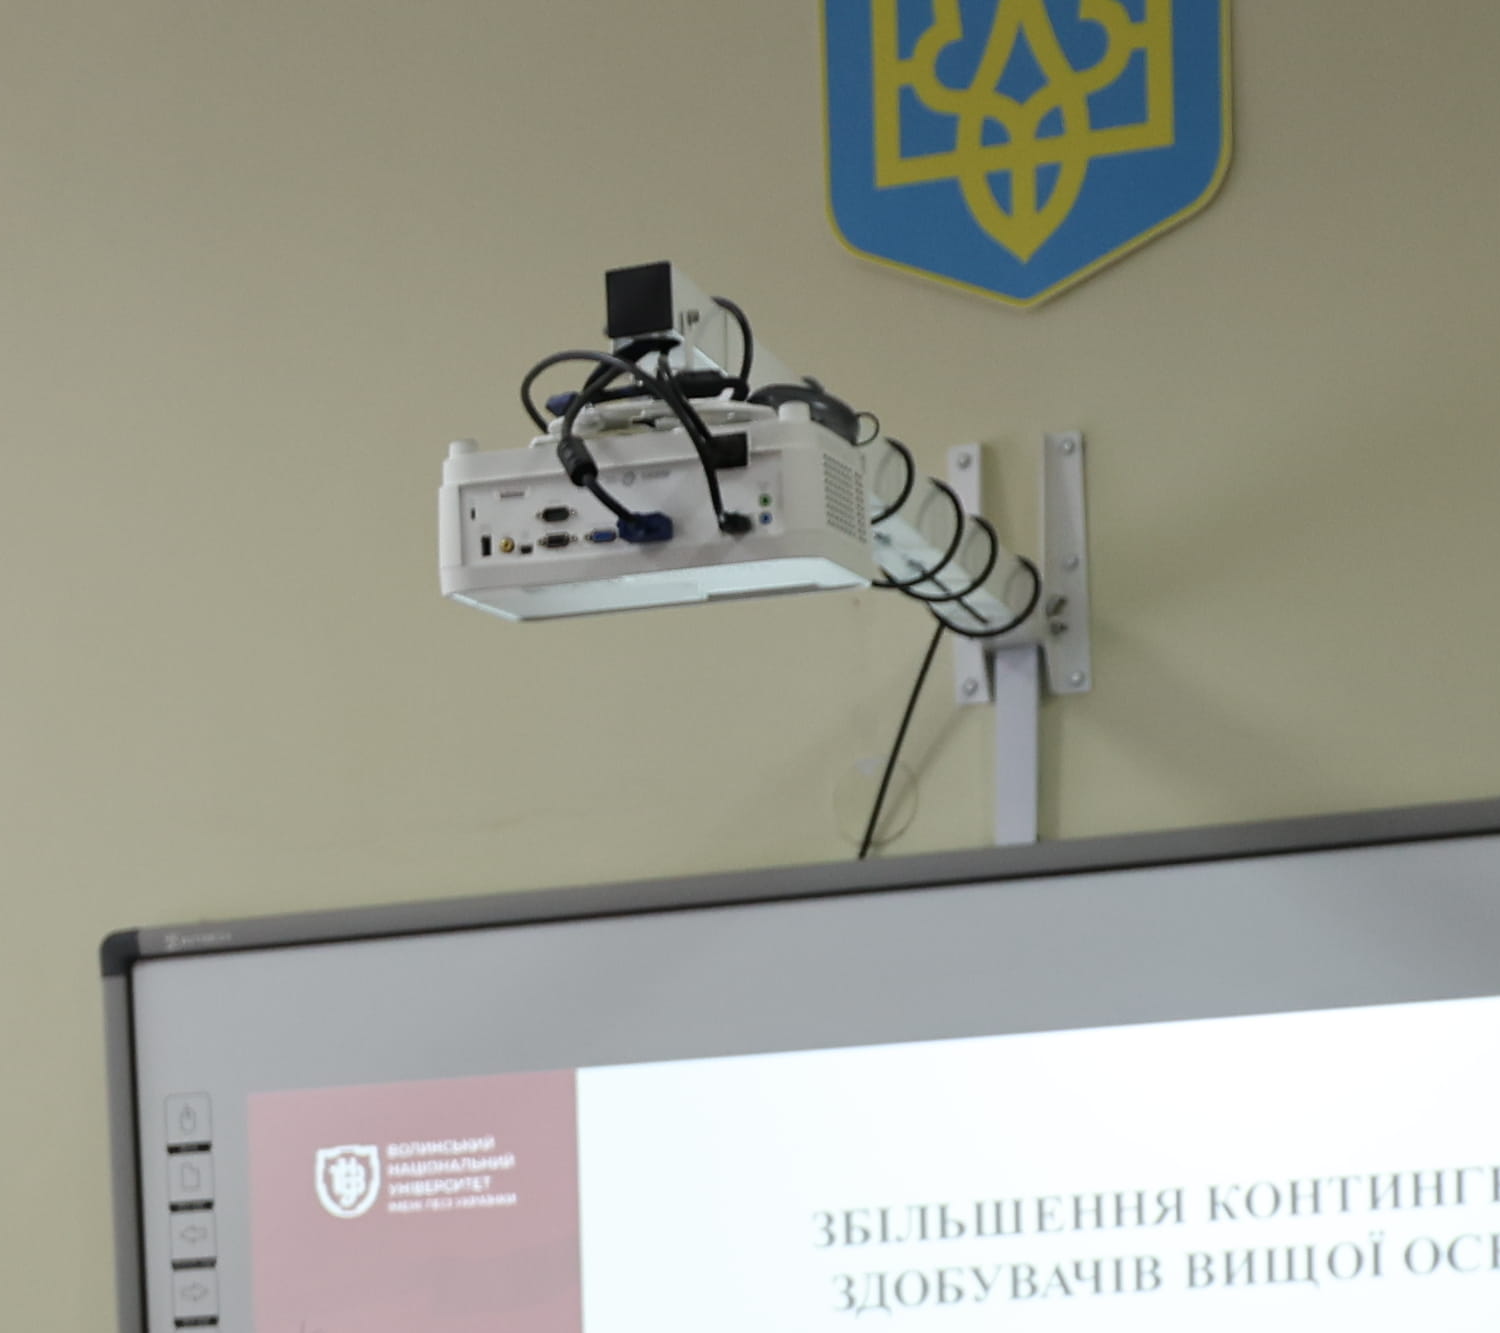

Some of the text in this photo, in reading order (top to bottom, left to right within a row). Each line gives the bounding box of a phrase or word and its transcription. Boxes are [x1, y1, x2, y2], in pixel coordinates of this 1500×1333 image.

[811, 1187, 1186, 1249] ЗБІЛЬШЕННЯ
[832, 1255, 1163, 1318] ЗДОБУВАЧІВ
[1185, 1230, 1385, 1290] ВИЩОЇ
